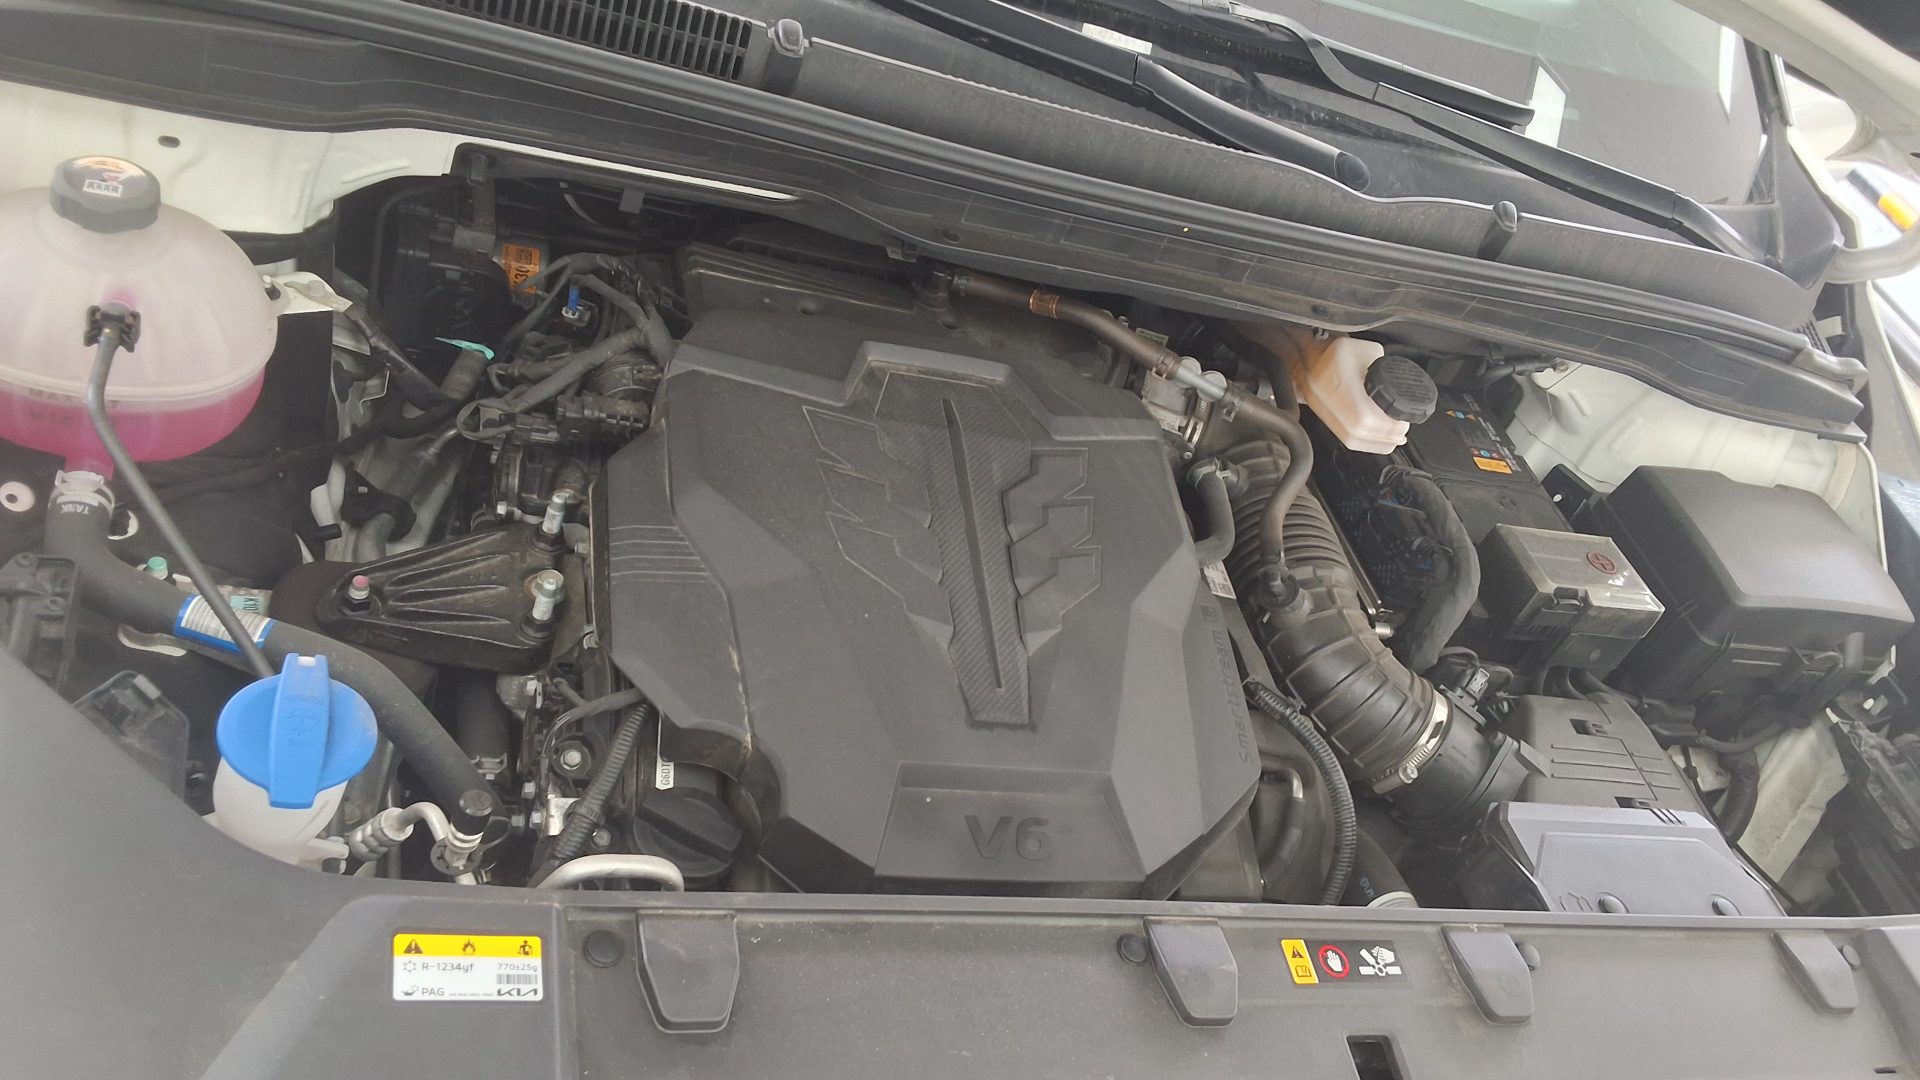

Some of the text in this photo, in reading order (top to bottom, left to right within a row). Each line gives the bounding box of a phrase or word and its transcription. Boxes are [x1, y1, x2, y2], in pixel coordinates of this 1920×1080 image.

[1212, 630, 1254, 766] Smartstream
[963, 814, 1052, 861] V6
[422, 962, 538, 973] R-1234yf 770±25g
[422, 987, 445, 997] PAG
